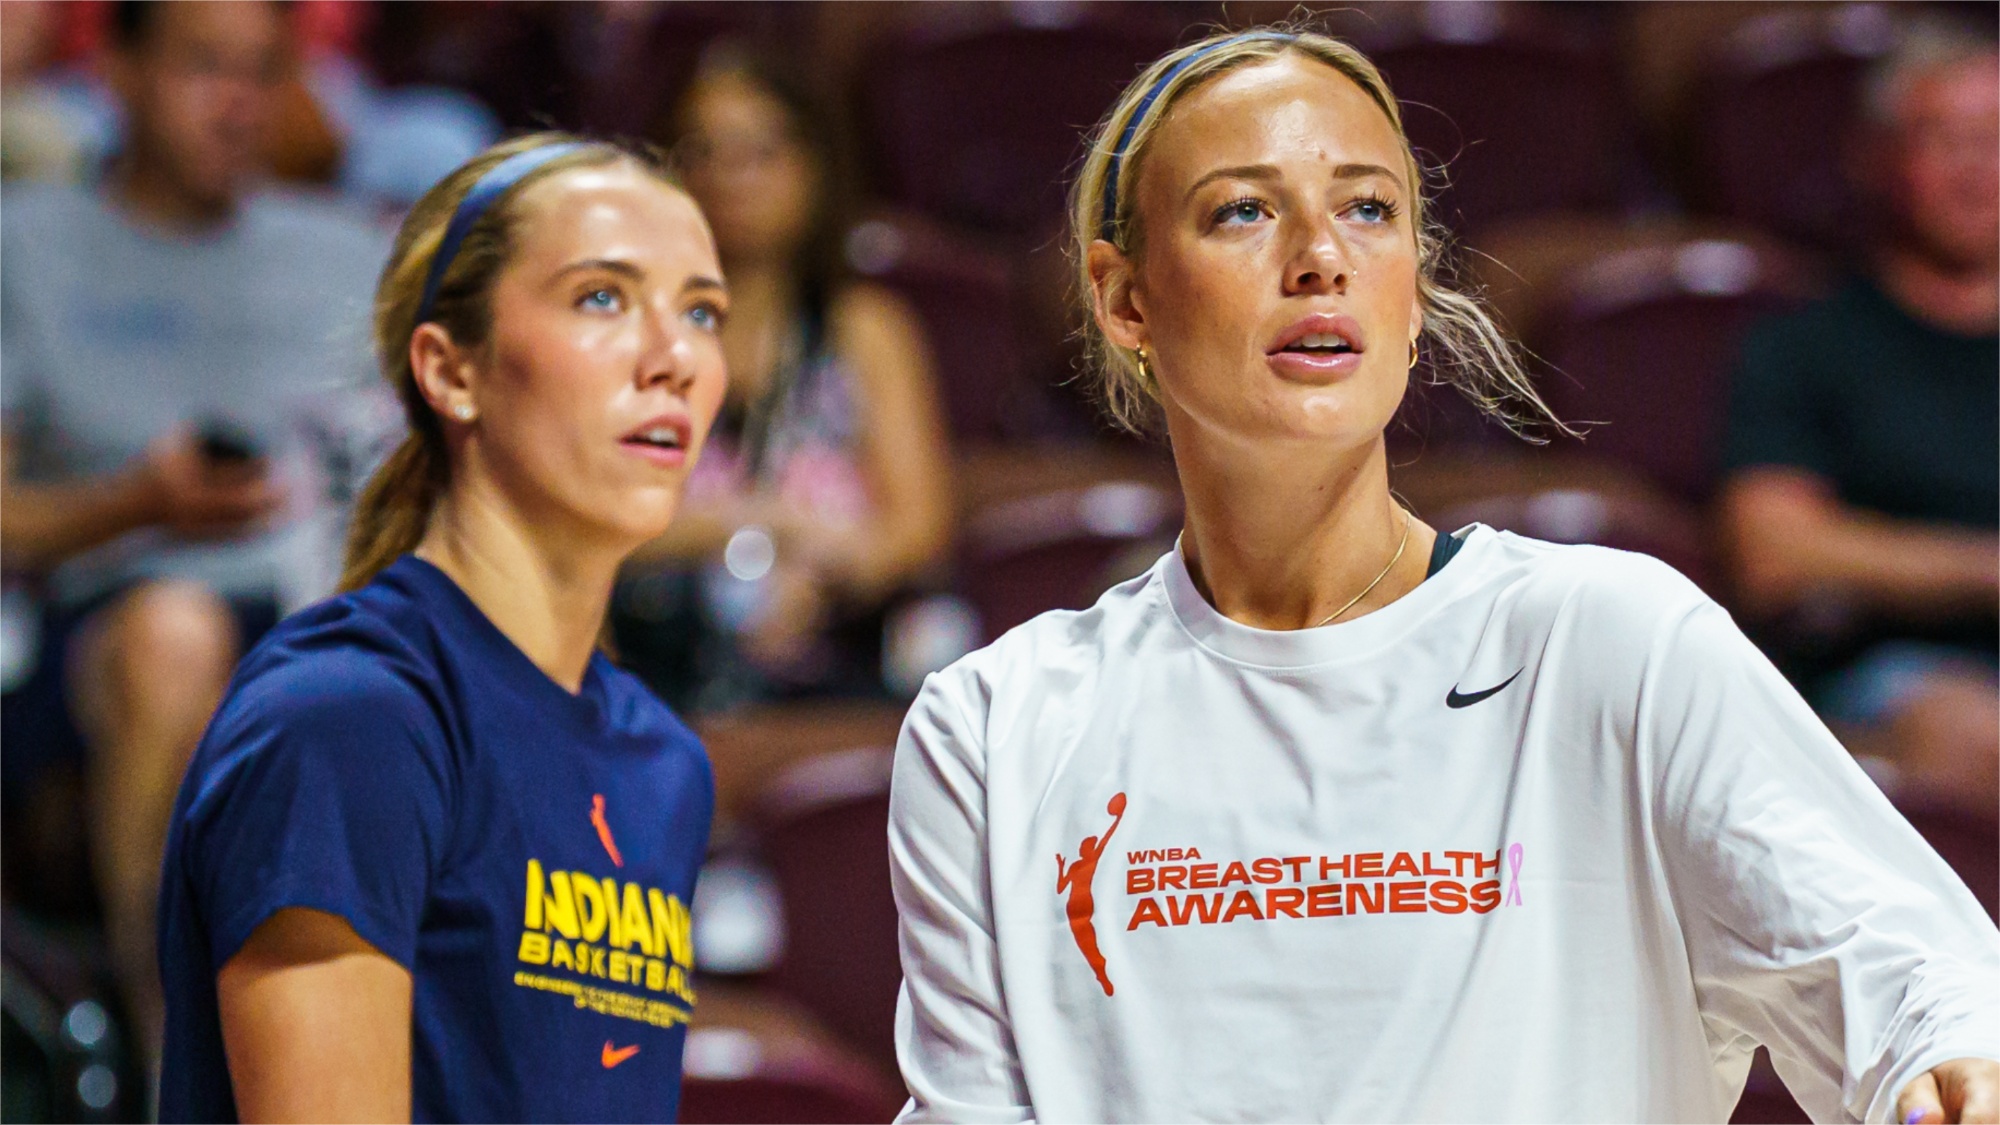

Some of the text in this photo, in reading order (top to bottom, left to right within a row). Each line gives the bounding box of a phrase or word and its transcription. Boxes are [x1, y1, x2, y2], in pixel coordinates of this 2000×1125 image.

[1126, 847, 1202, 865] WNBA
[1126, 849, 1500, 894] BREAST HEALTH
[1126, 879, 1502, 931] AWARENESS
[518, 930, 697, 1006] BASKETBAL
